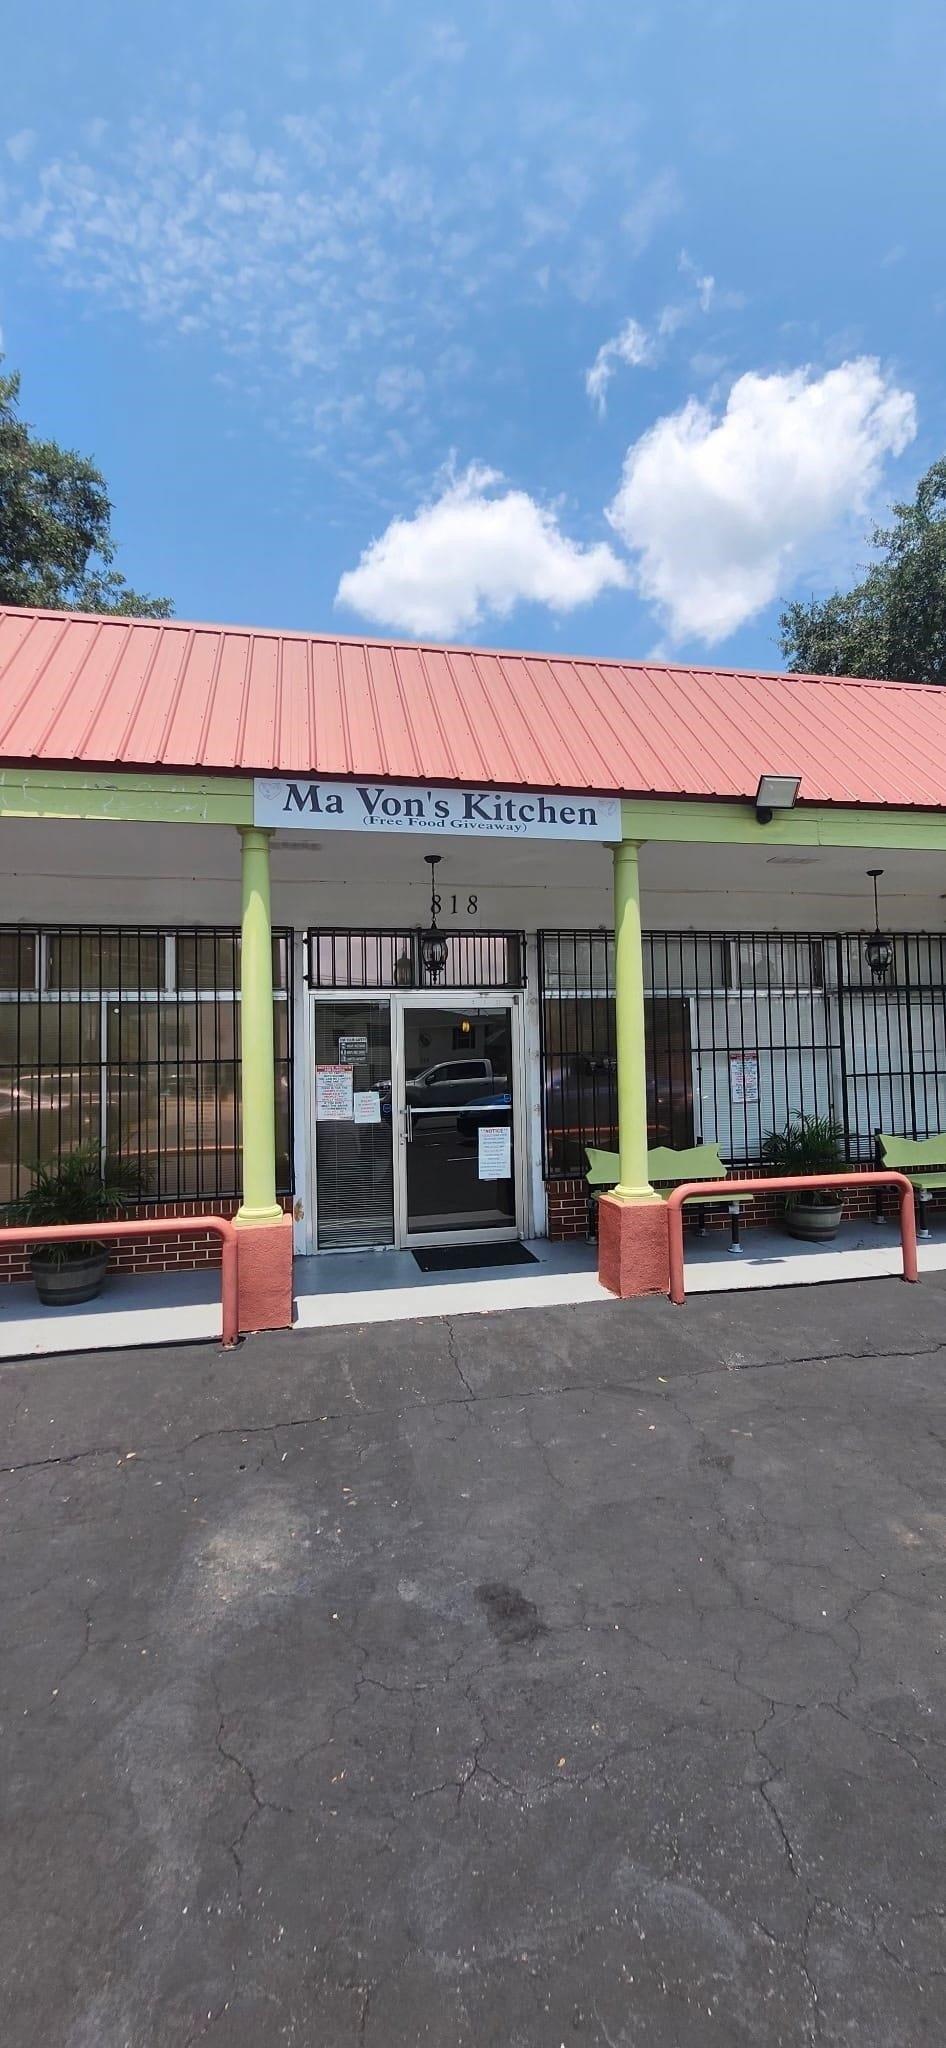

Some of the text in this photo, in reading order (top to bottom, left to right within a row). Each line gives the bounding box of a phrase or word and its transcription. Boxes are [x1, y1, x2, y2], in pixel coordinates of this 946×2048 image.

[283, 784, 598, 826] Ma Von's Kitchen
[363, 816, 527, 832] (Free Food Giveaway)
[431, 895, 478, 914] 818
